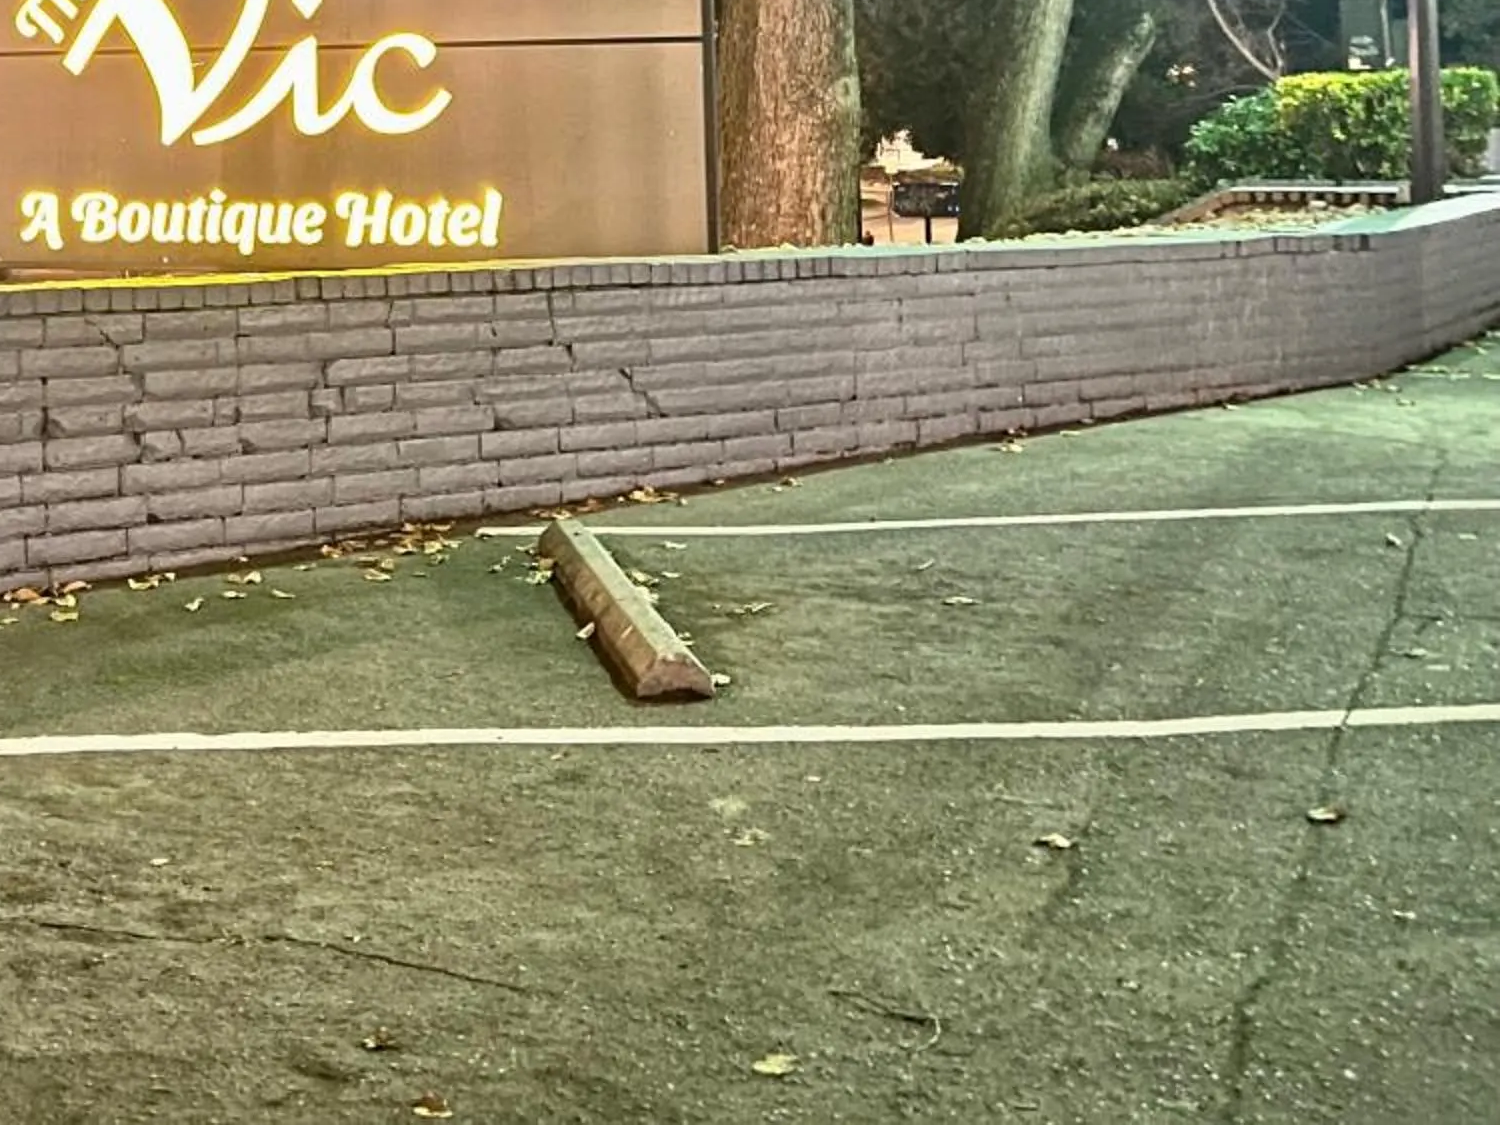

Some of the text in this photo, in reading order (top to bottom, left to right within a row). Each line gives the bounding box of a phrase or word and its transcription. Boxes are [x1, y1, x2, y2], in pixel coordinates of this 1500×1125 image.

[20, 187, 503, 255] A Boutique Hotel
